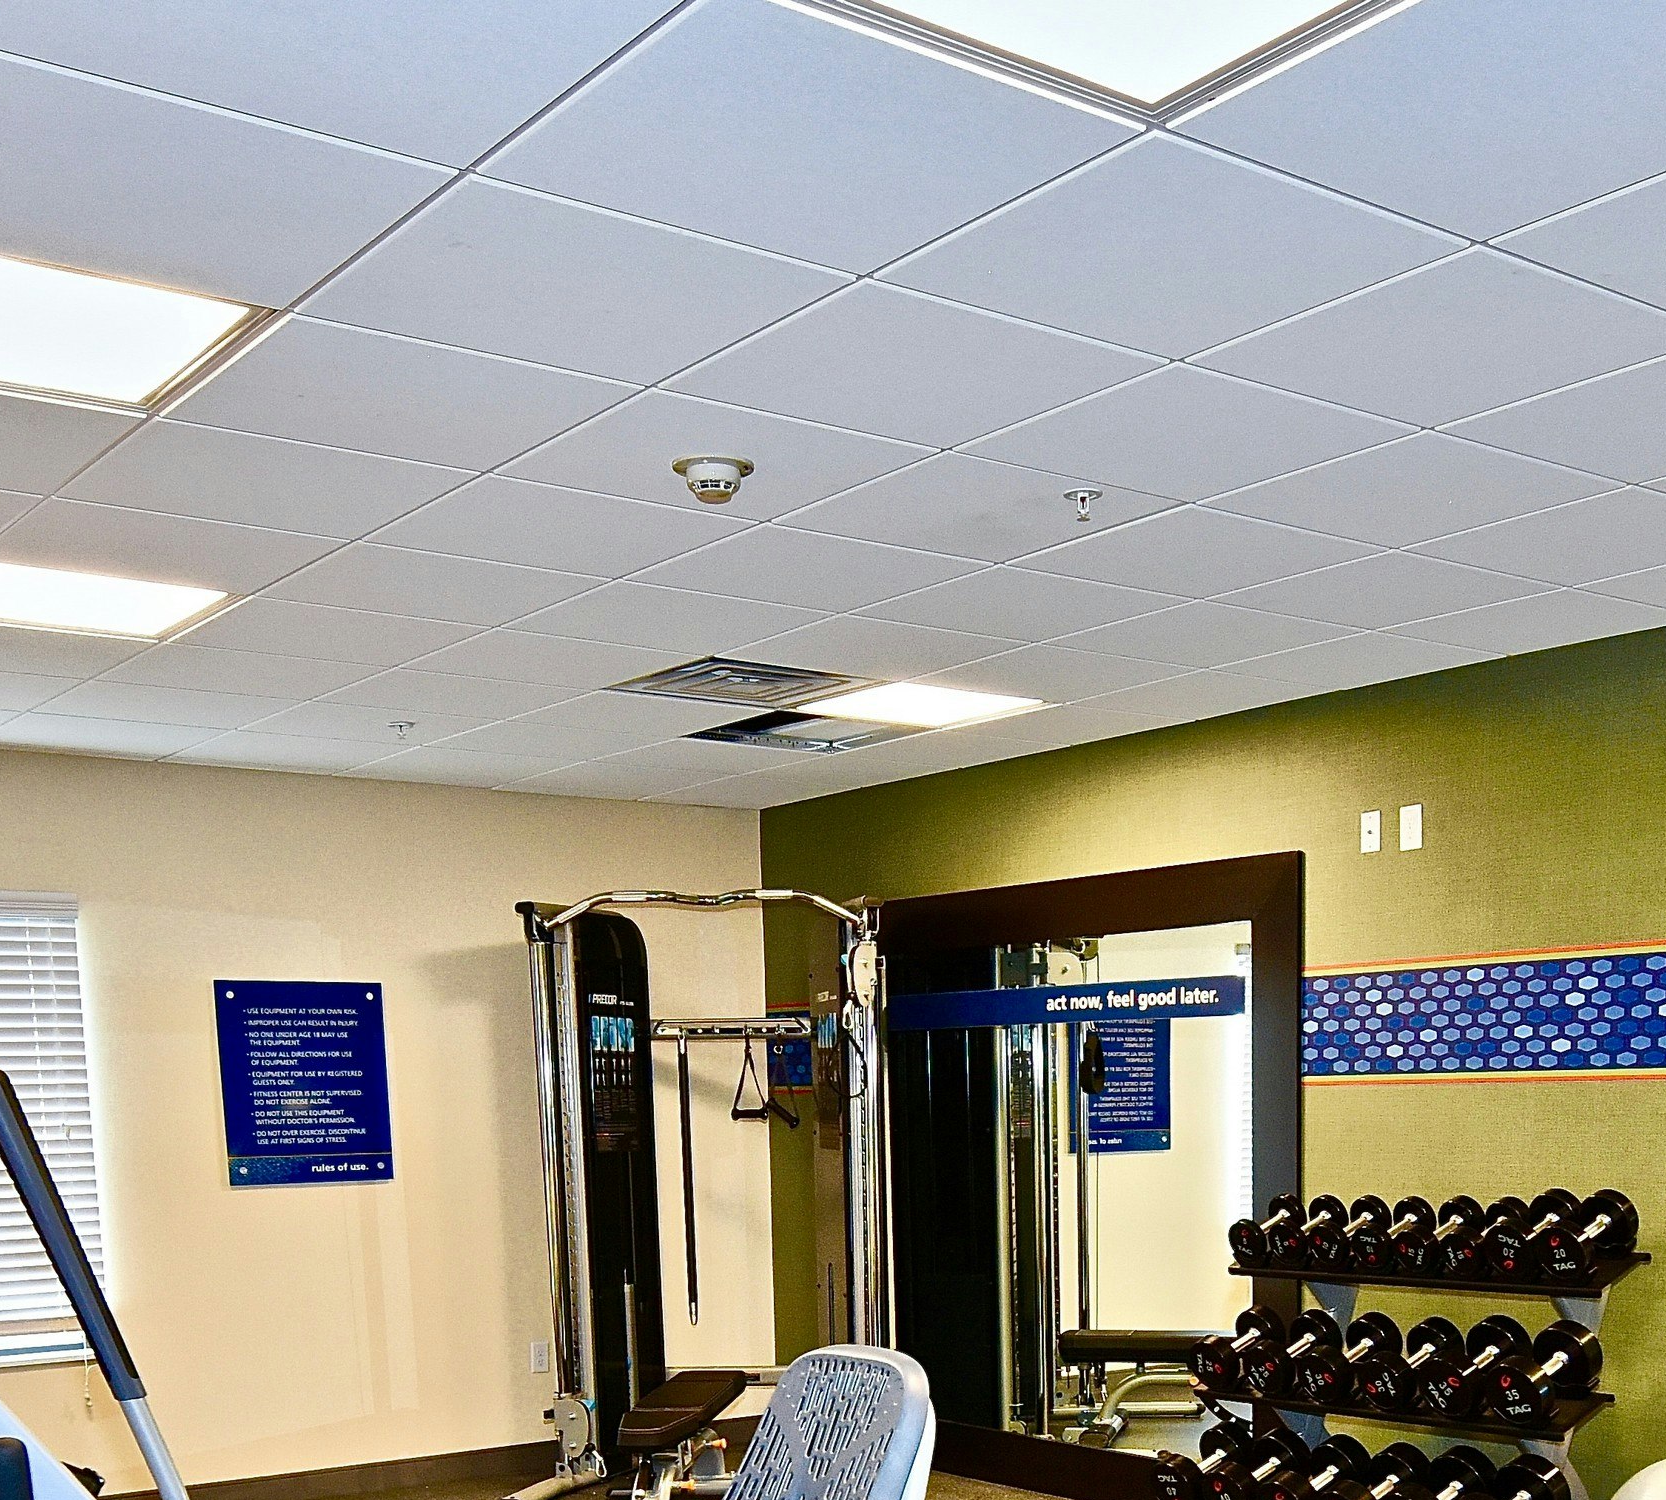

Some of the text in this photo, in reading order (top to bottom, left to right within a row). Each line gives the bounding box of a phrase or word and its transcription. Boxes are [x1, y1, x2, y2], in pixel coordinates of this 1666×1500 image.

[1046, 986, 1219, 1011] act now, feel good later.
[312, 1164, 335, 1172] rules
[337, 1163, 348, 1171] of
[1497, 1234, 1522, 1248] TAG
[1416, 1248, 1424, 1266] TAG
[1446, 1246, 1458, 1267] TAG
[1502, 1247, 1515, 1258] 20
[1553, 1248, 1566, 1259] 20
[1552, 1261, 1577, 1271] TAG
[1196, 1353, 1204, 1374] TAG
[1250, 1365, 1265, 1388] TAG
[1304, 1368, 1317, 1393] TAG
[1315, 1373, 1325, 1386] 30
[1382, 1372, 1398, 1397] TAG
[1438, 1381, 1454, 1397] 35
[1427, 1381, 1448, 1409] TAG
[1505, 1389, 1520, 1401] 35
[1505, 1404, 1532, 1416] TAG
[1157, 1475, 1178, 1483] TAG
